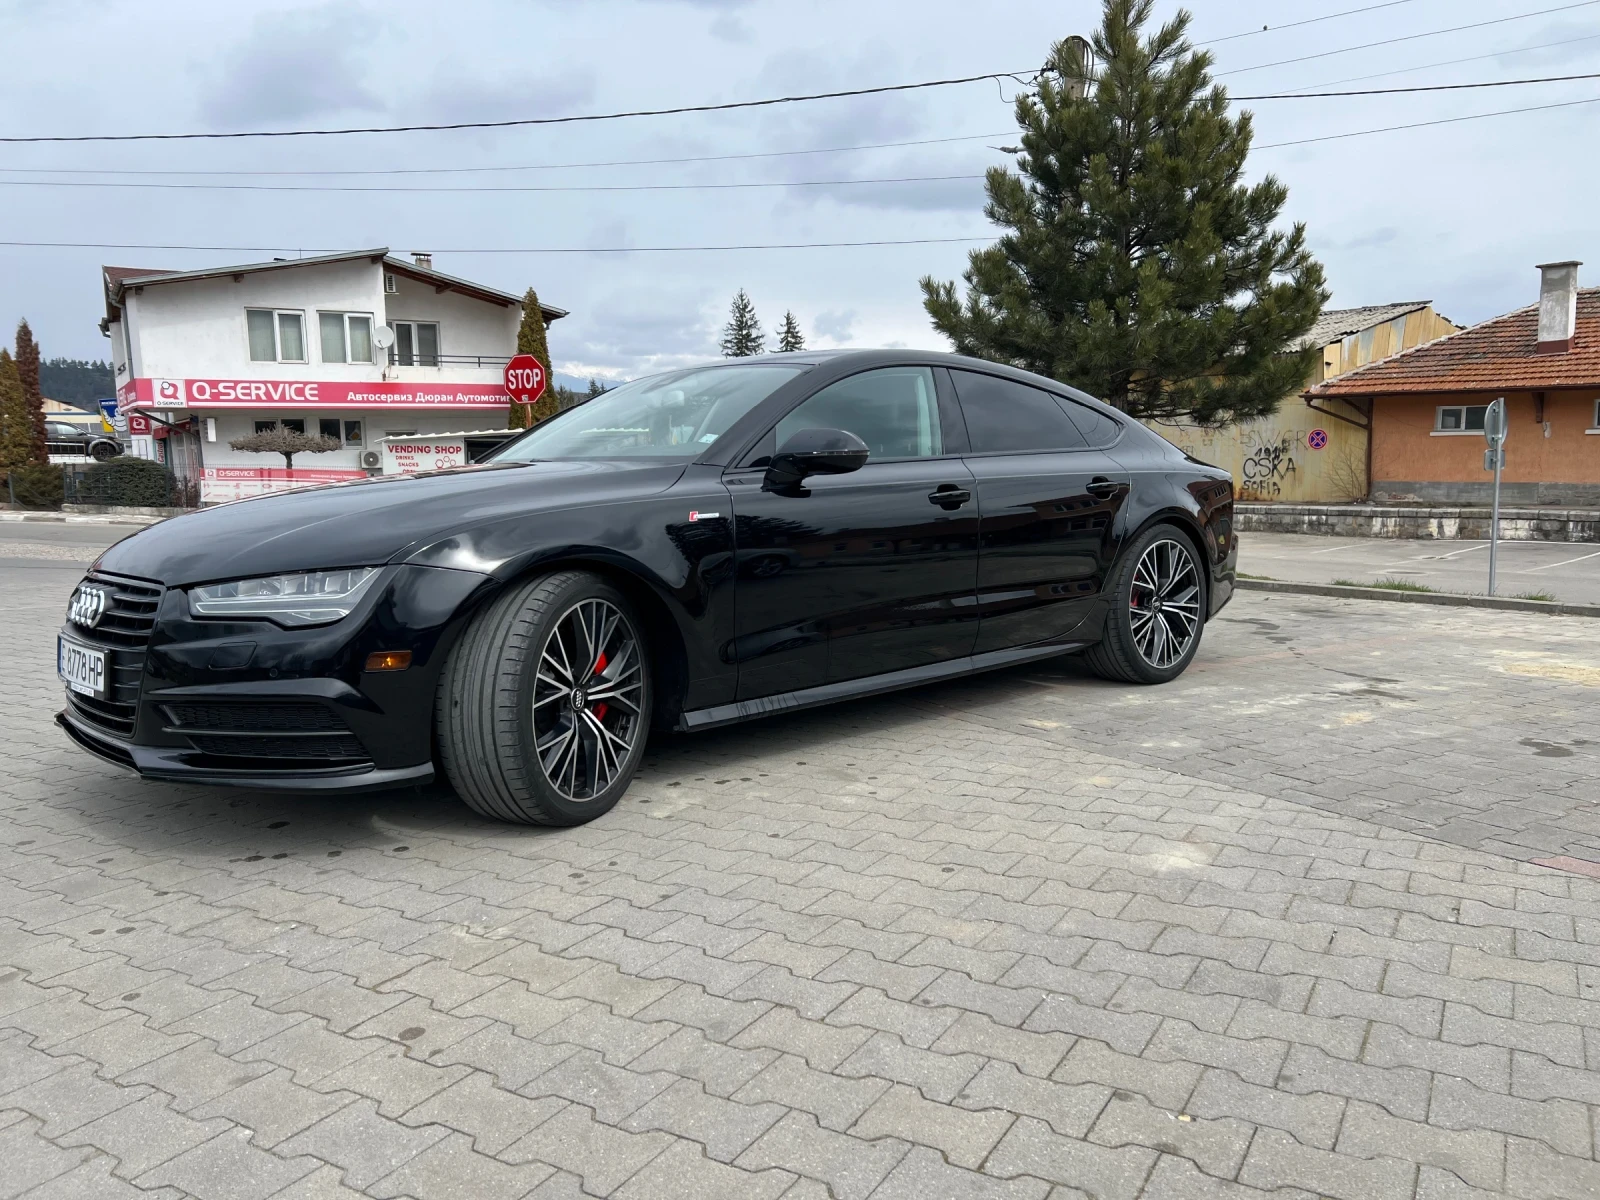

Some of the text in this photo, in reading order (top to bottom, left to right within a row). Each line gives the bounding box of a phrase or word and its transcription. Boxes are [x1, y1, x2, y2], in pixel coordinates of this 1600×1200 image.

[508, 368, 541, 389] STOP
[192, 382, 319, 401] Q-SERVICE
[347, 392, 412, 402] Автосервиз
[415, 392, 453, 404] Дюран
[387, 445, 462, 454] VENDING SHOP
[1243, 457, 1296, 481] CSKA
[67, 646, 87, 682] 8778
[88, 653, 104, 687] HP
